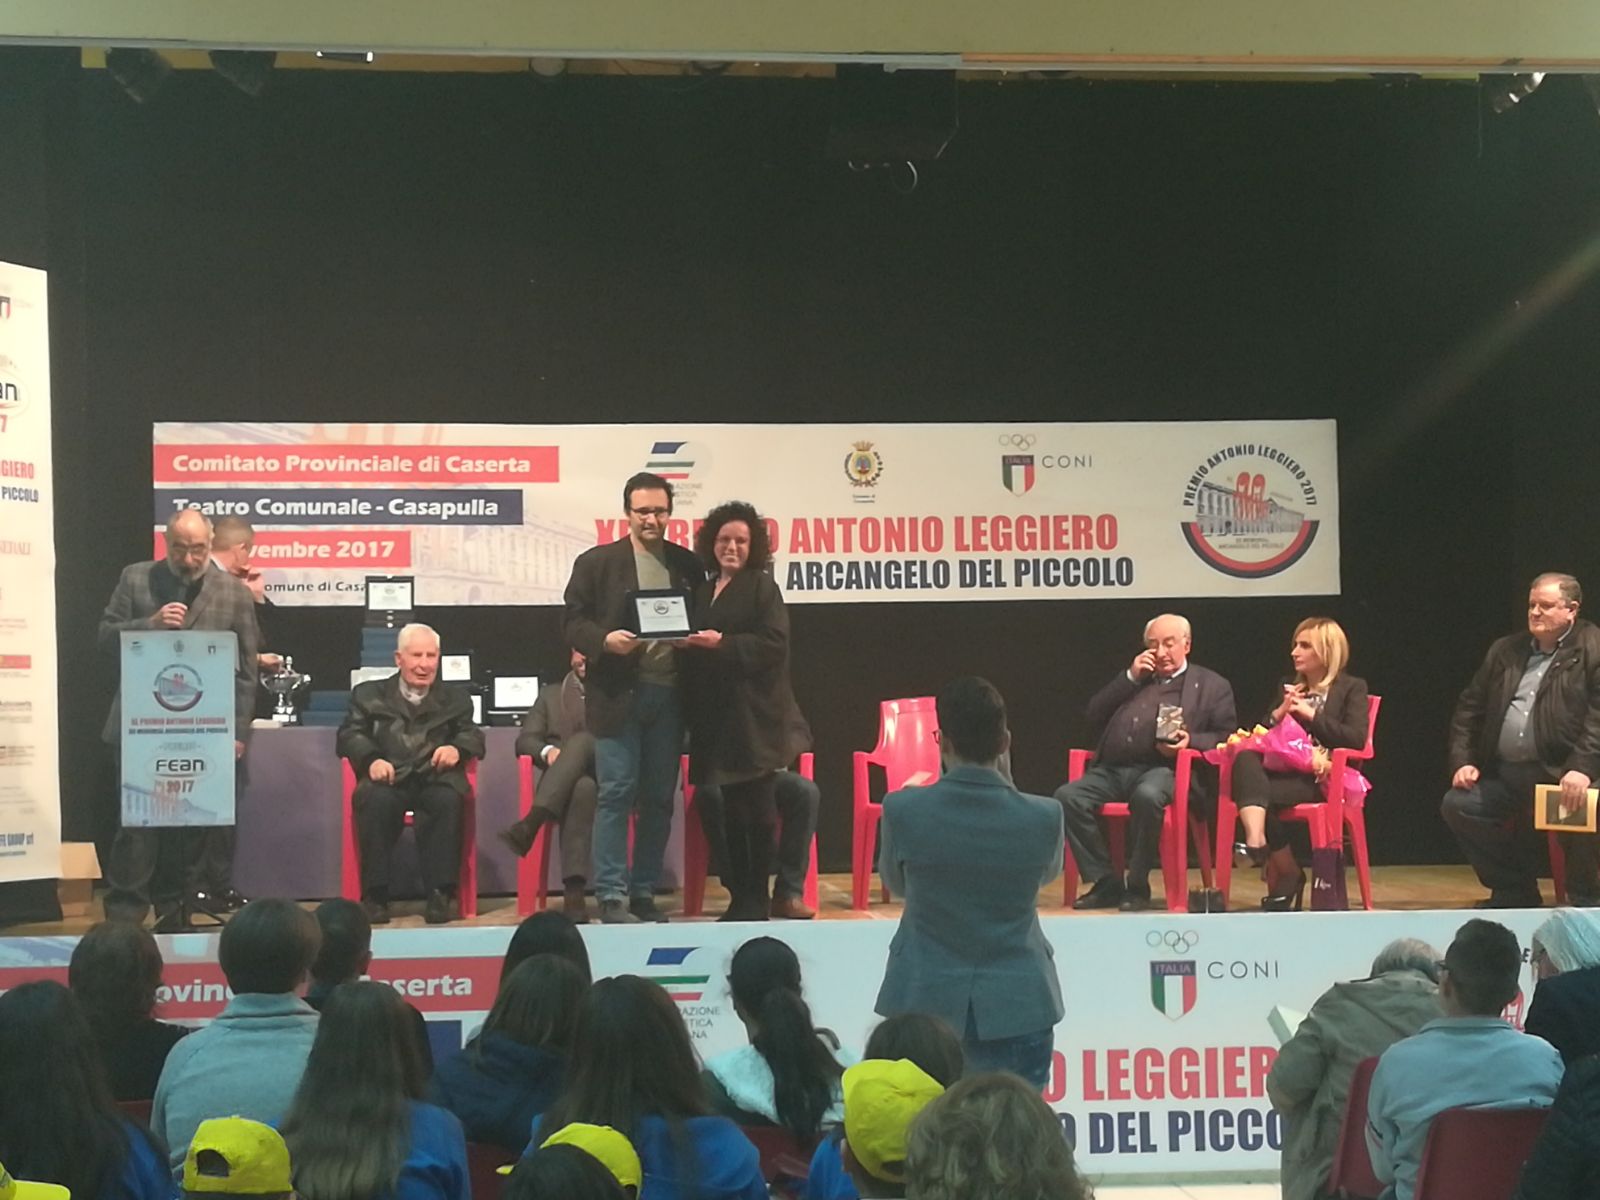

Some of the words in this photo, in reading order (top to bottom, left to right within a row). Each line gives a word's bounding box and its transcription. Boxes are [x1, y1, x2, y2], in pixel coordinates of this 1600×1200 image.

[0, 459, 34, 480] GIERO
[172, 455, 280, 472] Comitato
[286, 455, 413, 472] Provinciale
[418, 456, 440, 472] di
[445, 456, 531, 473] Caserta
[1042, 454, 1093, 469] CONI
[1183, 464, 1209, 507] PREMIO
[1207, 443, 1255, 469] ANTONIO
[1257, 443, 1306, 481] LEGGIERO
[1299, 479, 1318, 506] 2017
[173, 498, 250, 516] Teatro
[255, 498, 372, 516] Comunale
[388, 498, 499, 520] Casapulla
[788, 515, 944, 554] ANTONIO
[954, 513, 1119, 552] LEGGIERO
[247, 541, 331, 559] vembre
[336, 541, 396, 558] 2017
[786, 559, 951, 591] ARCANGELO
[959, 558, 1007, 589] DEL
[1014, 556, 1135, 588] PICCOLO
[264, 583, 314, 592] omune
[317, 581, 331, 592] di
[1154, 963, 1192, 975] ITALIA
[1207, 960, 1279, 980] CONI
[358, 974, 473, 997] serta
[679, 1006, 721, 1016] AZIONE
[690, 1019, 714, 1028] TICA
[1082, 1046, 1279, 1102] LEGGIER
[1089, 1111, 1157, 1155] DEL
[1168, 1108, 1282, 1152] PICCO
